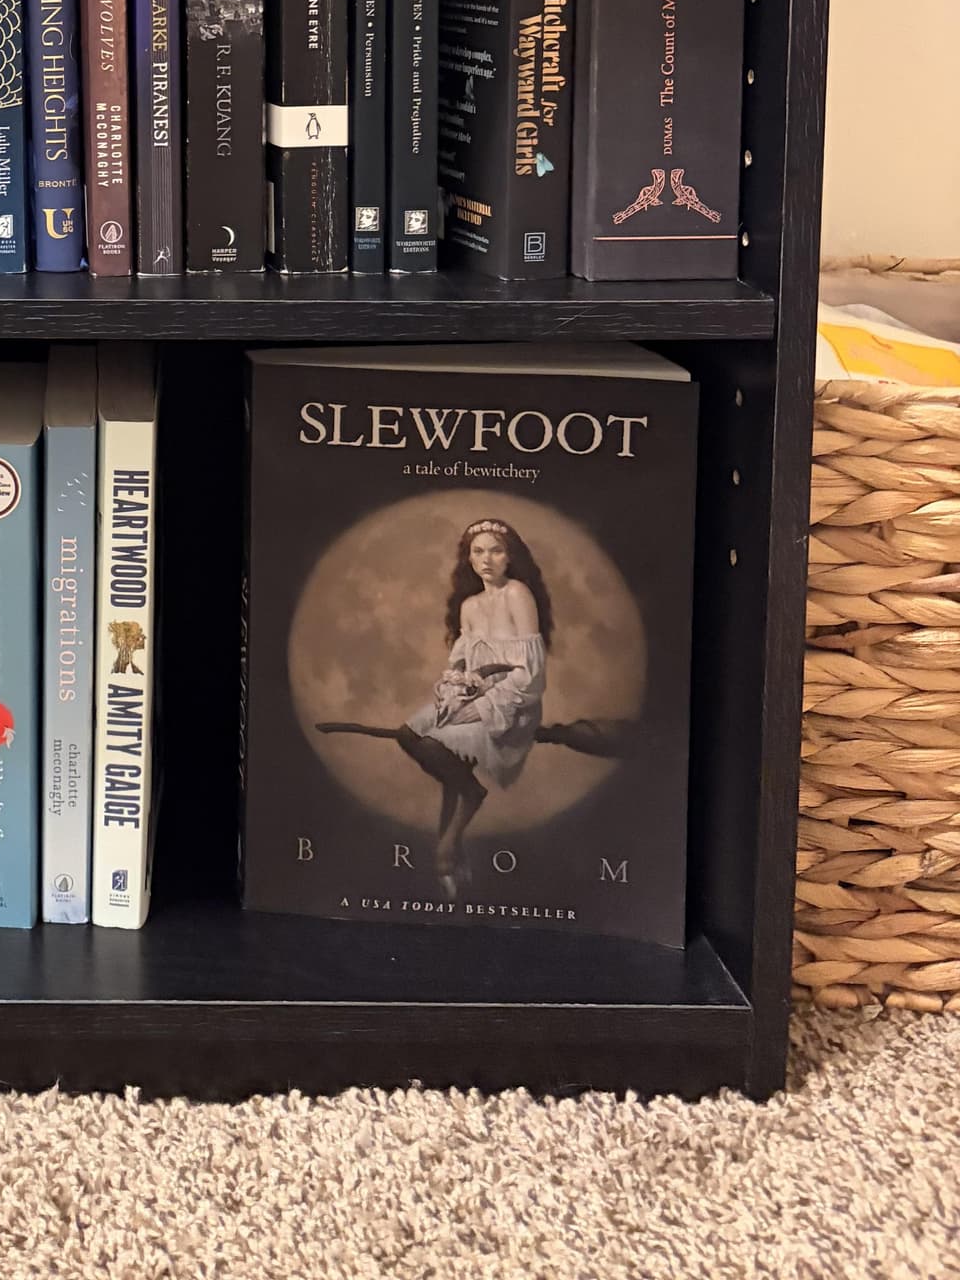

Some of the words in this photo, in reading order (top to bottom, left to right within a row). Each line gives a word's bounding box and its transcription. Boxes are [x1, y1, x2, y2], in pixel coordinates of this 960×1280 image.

[664, 10, 676, 29] of
[365, 32, 375, 97] Persuasion
[514, 14, 542, 118] Wayward
[660, 32, 675, 77] Count
[42, 55, 68, 161] HEIGHTS
[152, 62, 168, 147] PIRANESI
[660, 79, 674, 107] The
[110, 105, 123, 184] CHARLOTTE
[515, 121, 539, 176] Girls
[663, 117, 673, 156] DUMAS
[299, 402, 648, 458] SLEWFOOT
[403, 464, 411, 476] a
[415, 462, 440, 476] tale
[443, 461, 461, 477] of
[464, 463, 540, 484] bewitchery
[110, 470, 150, 608] HEARTWOOD
[51, 536, 84, 702] migrations
[106, 683, 144, 757] AMITY
[104, 763, 142, 829] GAIGE
[340, 897, 350, 907] A
[361, 898, 391, 910] USA
[401, 901, 456, 914] TODAY
[465, 903, 578, 920] BESTSELLER
